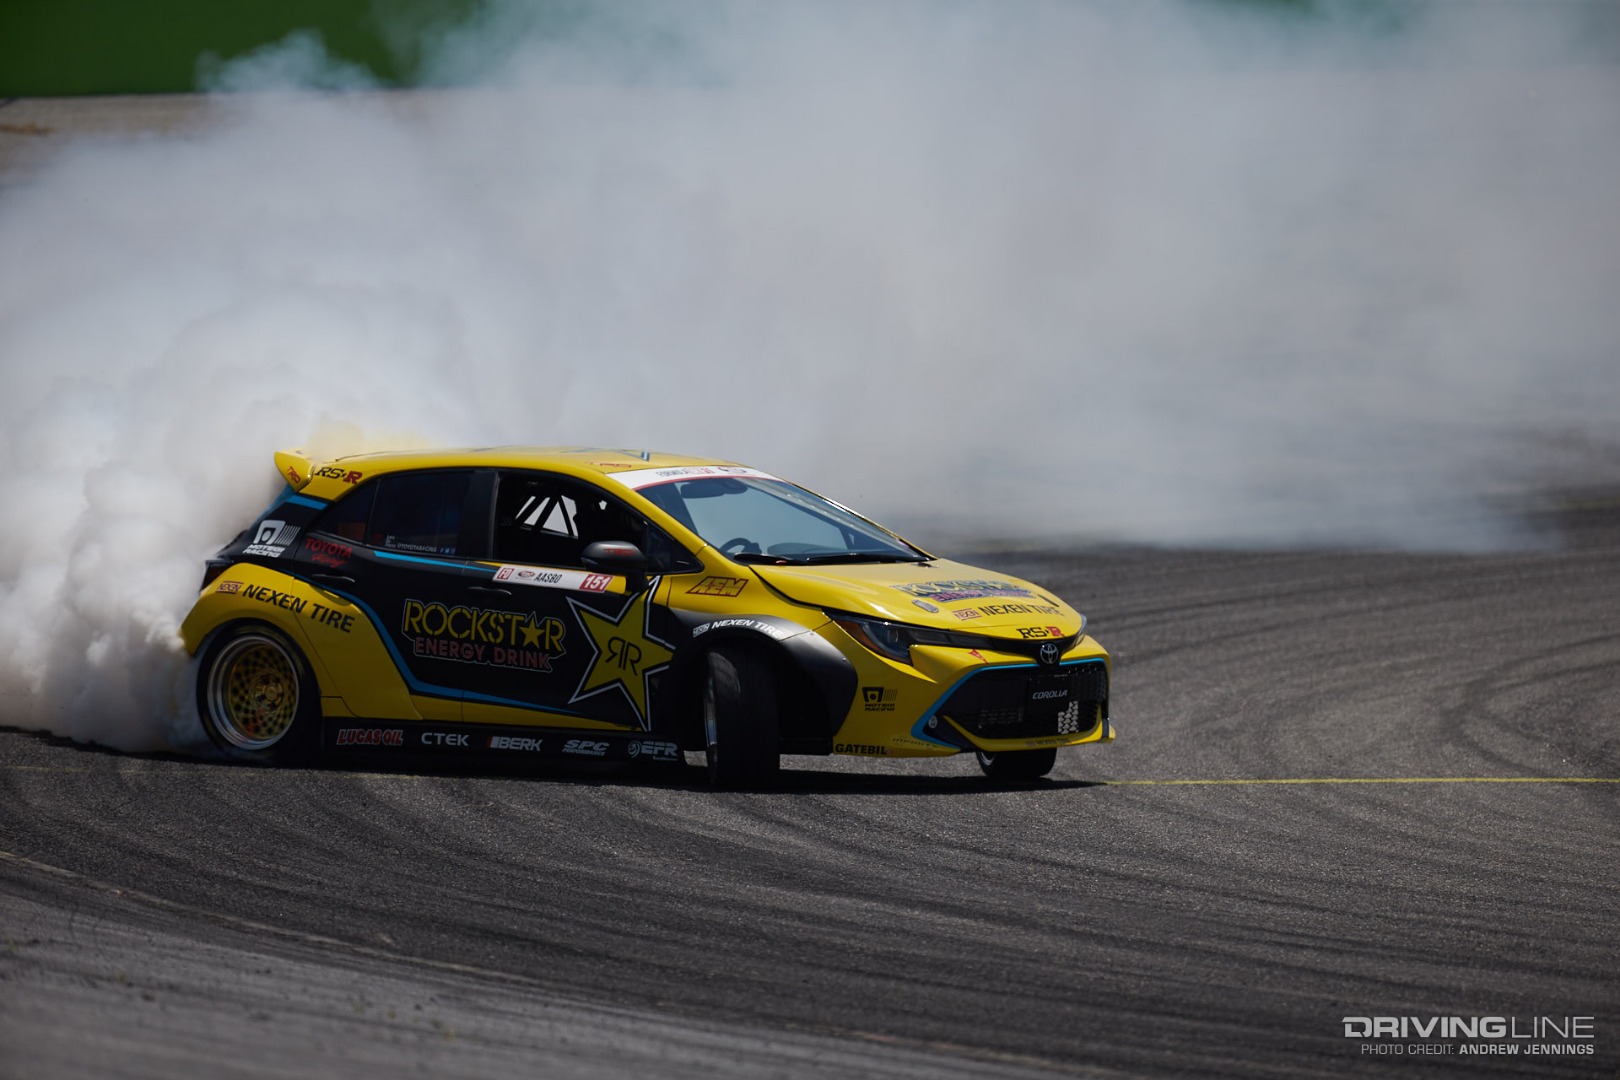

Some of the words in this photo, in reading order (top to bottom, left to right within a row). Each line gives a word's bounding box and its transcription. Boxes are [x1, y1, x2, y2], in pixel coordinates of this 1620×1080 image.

[305, 537, 353, 558] TOYOTA
[533, 572, 562, 584] AASBO
[584, 575, 610, 590] 151
[243, 584, 308, 614] NEXEN
[310, 603, 355, 633] TIRE
[981, 604, 1032, 617] NEXEN
[712, 619, 755, 629] NEXEN
[753, 621, 785, 638] TIRE
[415, 636, 486, 661] ENERGY
[493, 646, 552, 670] DRINK
[1032, 689, 1068, 700] COROLLA
[336, 729, 381, 745] LUCAS
[382, 729, 404, 746] OIL
[421, 731, 470, 747] CTEK
[498, 736, 543, 752] BERK
[564, 739, 610, 751] SPC
[641, 740, 679, 756] EFR
[835, 744, 887, 755] GATEBIL
